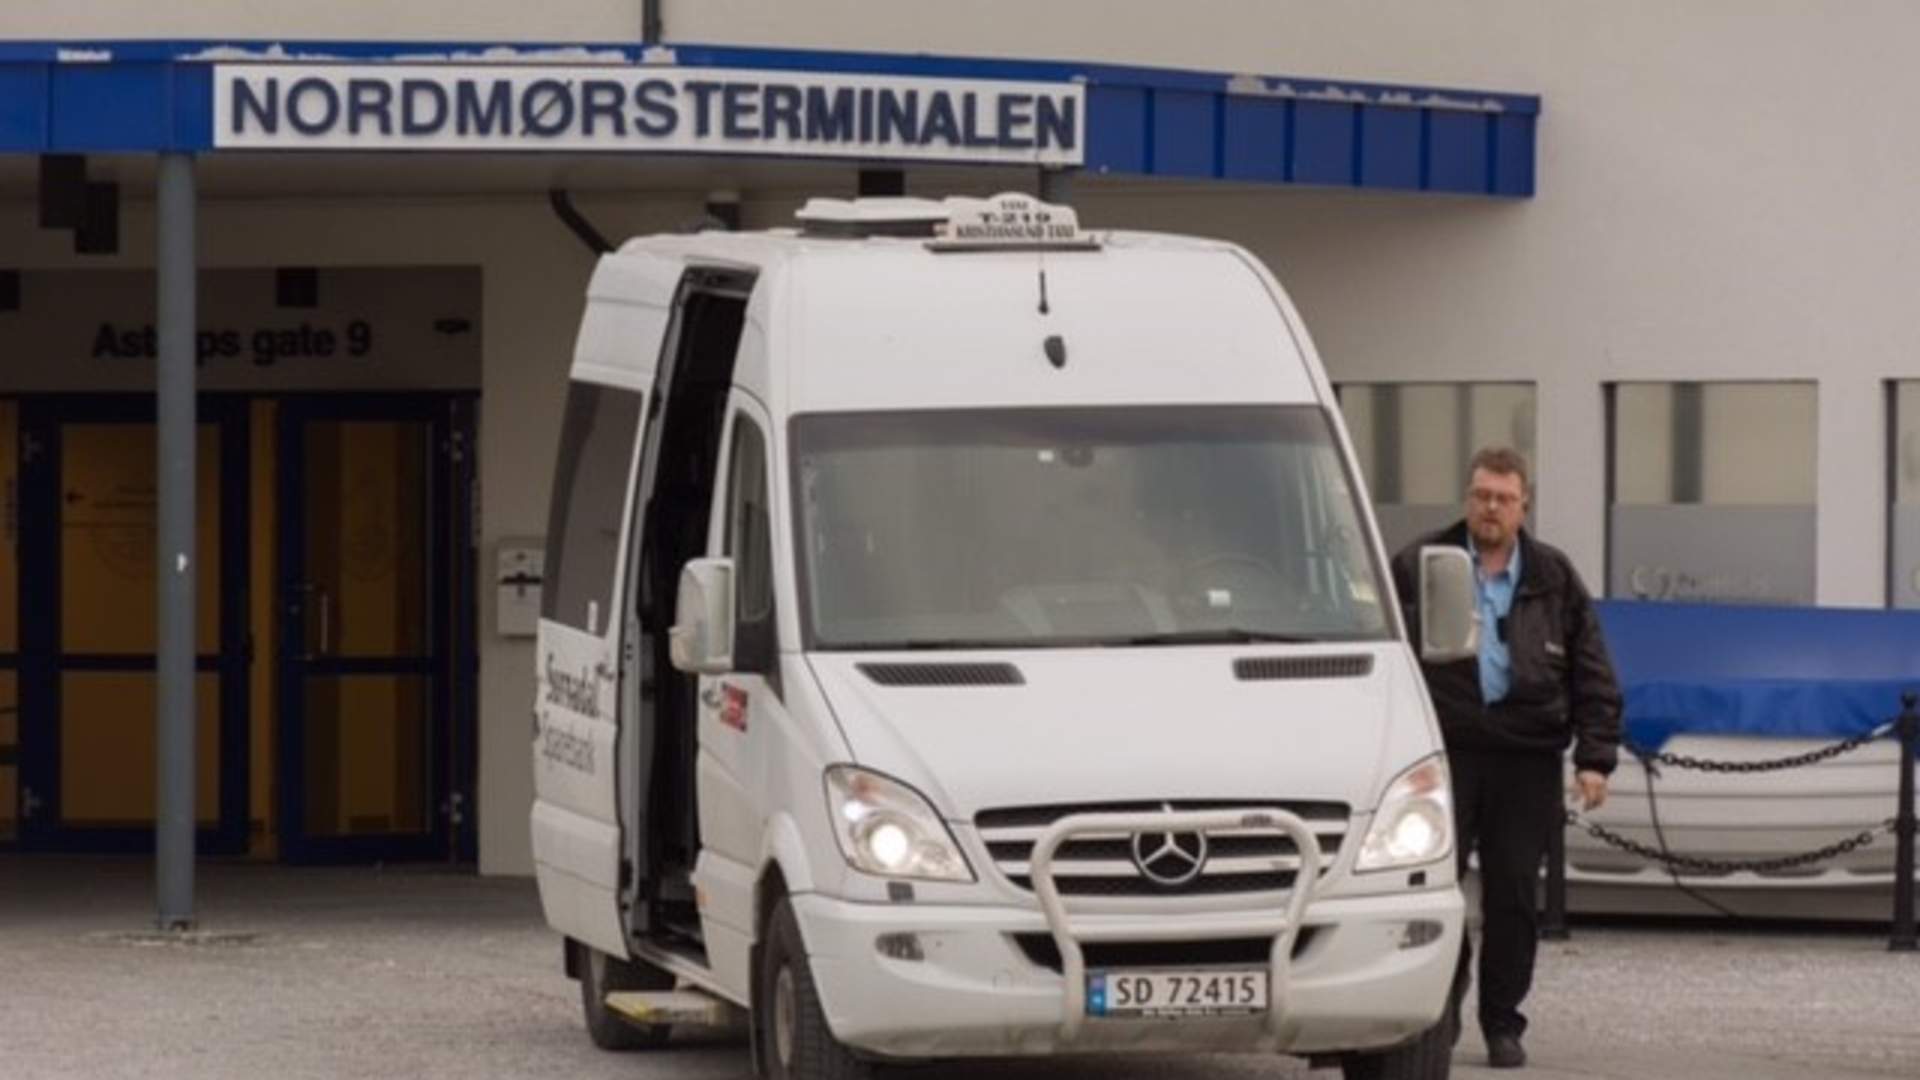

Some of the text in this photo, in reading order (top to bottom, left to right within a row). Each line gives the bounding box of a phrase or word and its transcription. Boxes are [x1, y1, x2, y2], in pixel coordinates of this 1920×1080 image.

[230, 77, 1077, 150] NORDMØRSTERMINALEN
[93, 320, 372, 367] Astps gate 9
[1115, 975, 1256, 1006] SD 72415
